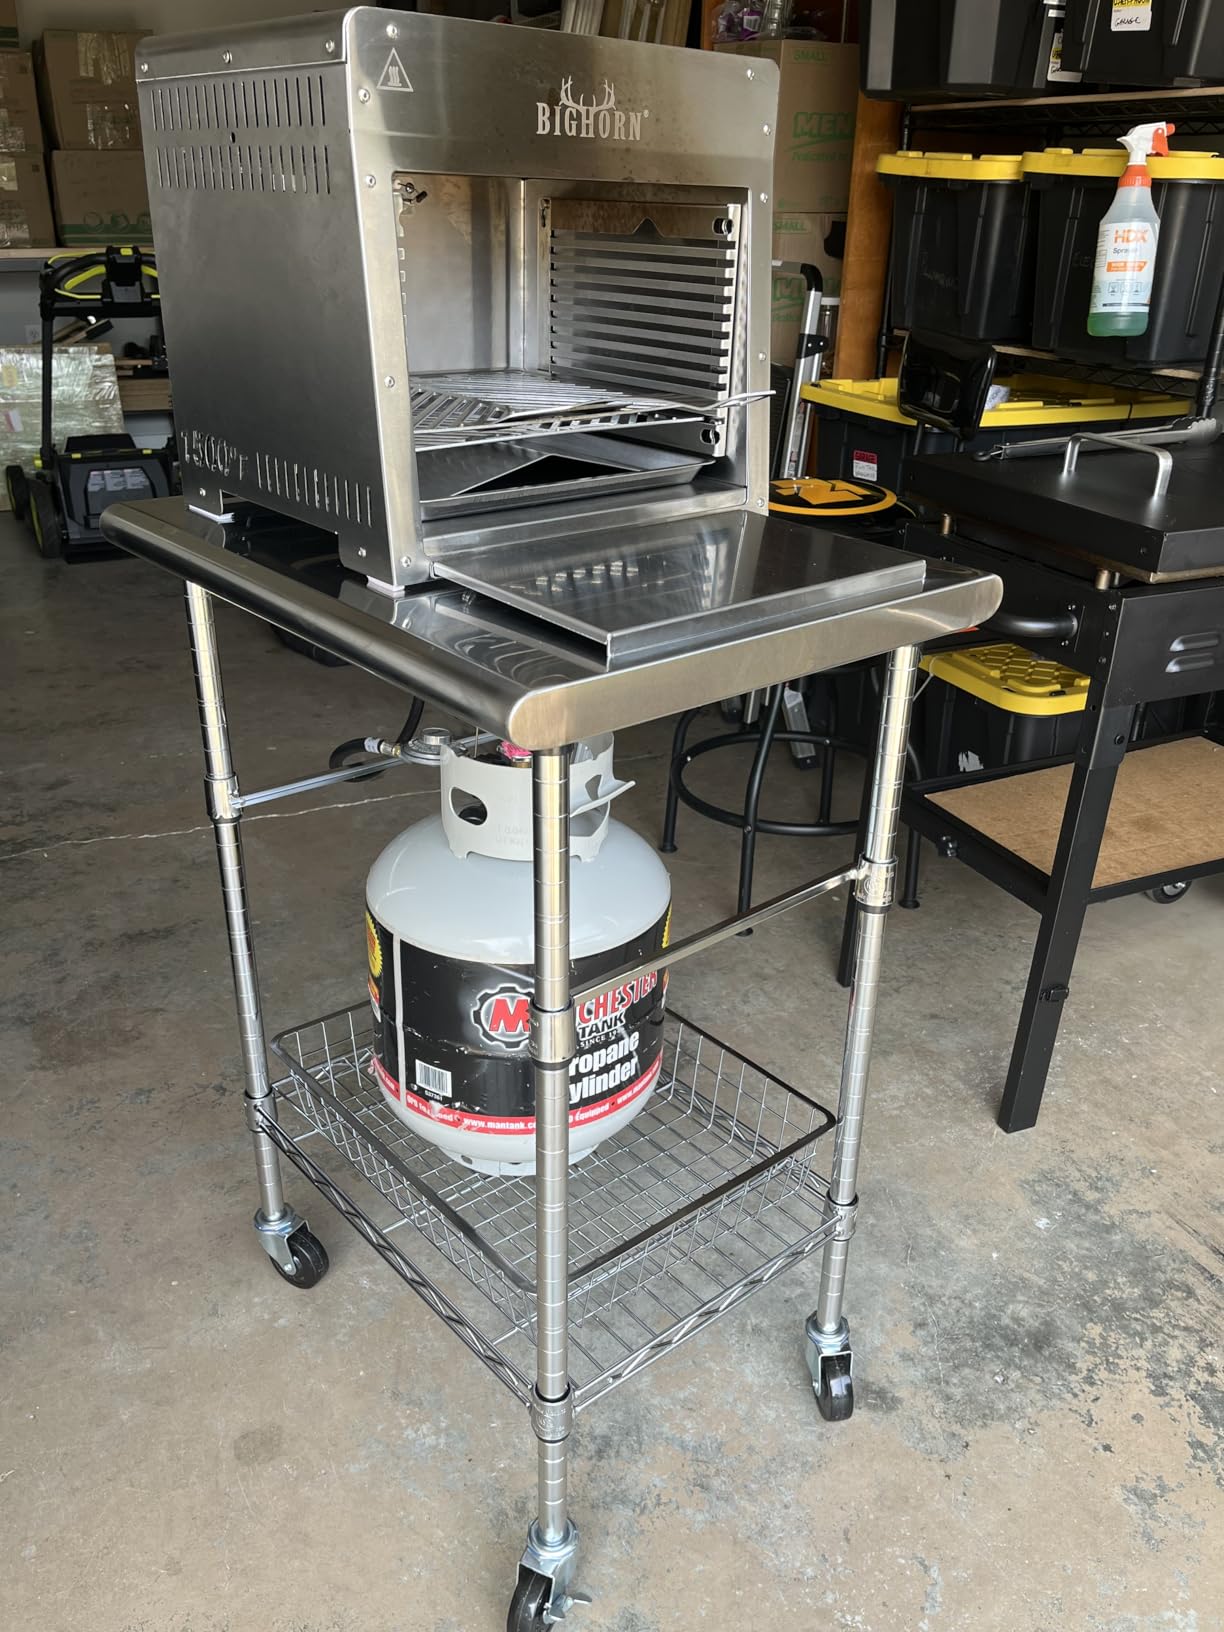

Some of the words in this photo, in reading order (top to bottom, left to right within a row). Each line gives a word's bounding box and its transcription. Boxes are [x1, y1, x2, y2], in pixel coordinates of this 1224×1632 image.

[536, 102, 641, 141] BIGHORN
[792, 112, 854, 138] MEN
[1114, 229, 1148, 243] HDX
[578, 970, 658, 1024] CHESTER
[579, 1012, 624, 1039] TANK
[580, 1034, 606, 1048] SINCE
[569, 1031, 639, 1076] ropane
[569, 1056, 638, 1104] ylinder
